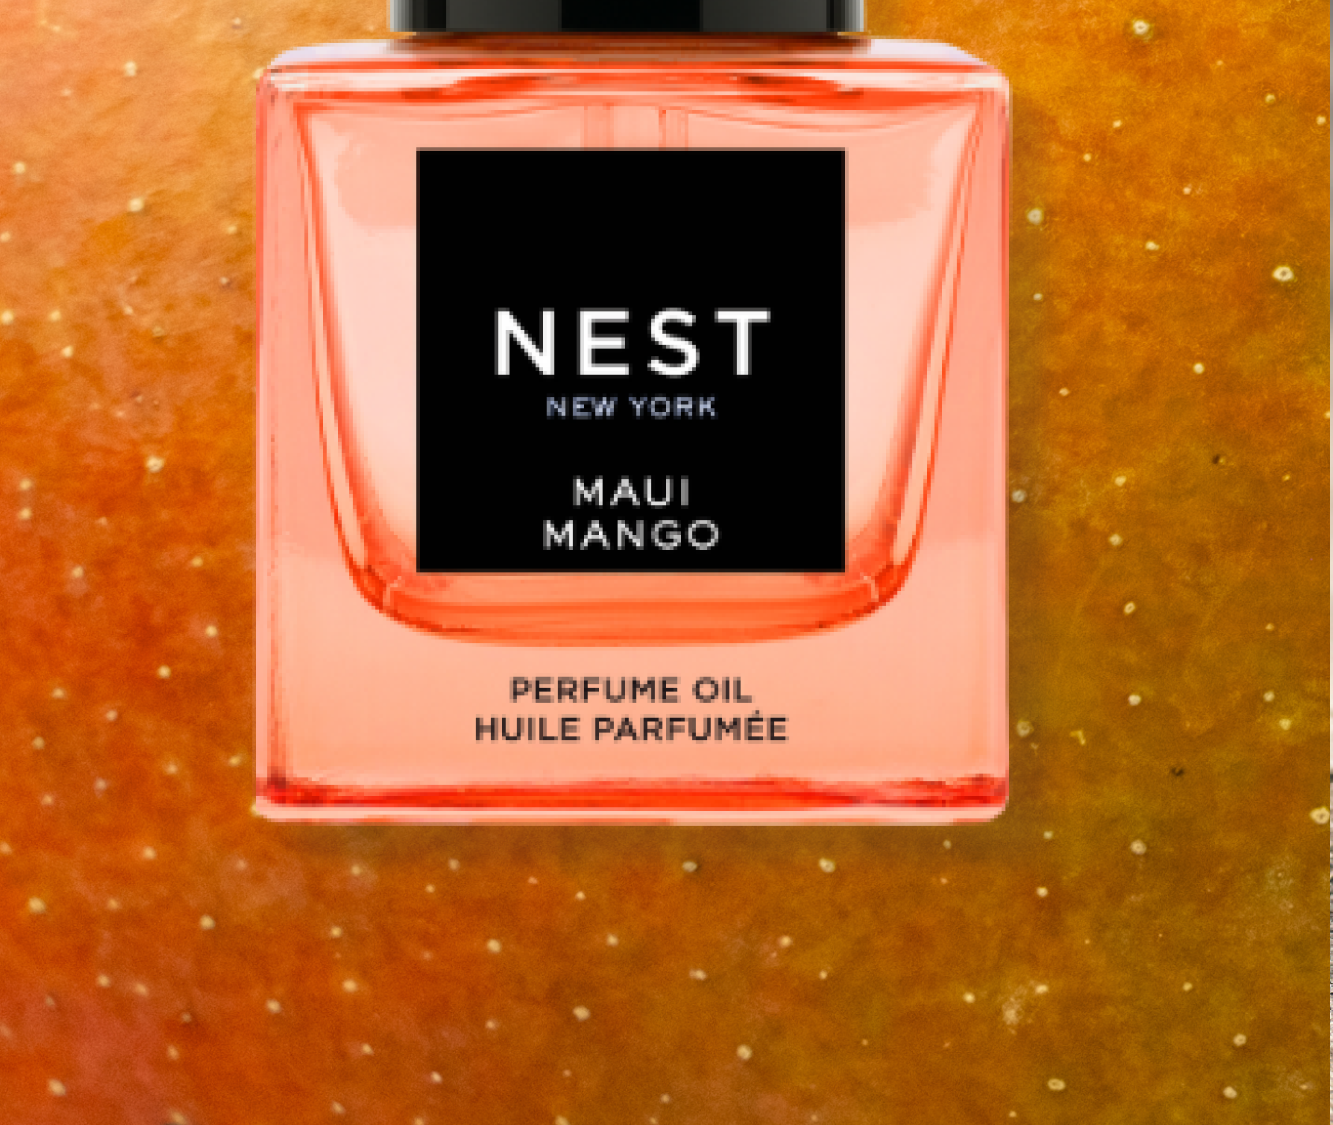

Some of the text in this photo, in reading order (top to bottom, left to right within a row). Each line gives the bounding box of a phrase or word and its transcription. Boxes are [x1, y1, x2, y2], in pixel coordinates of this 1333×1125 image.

[495, 307, 772, 378] NEST
[546, 396, 717, 420] NEW YORK
[572, 475, 690, 507] MAUI
[542, 519, 720, 551] MANGO
[510, 676, 754, 704] PERFUME OIL
[474, 709, 788, 743] HUILE PARFUMÉE
